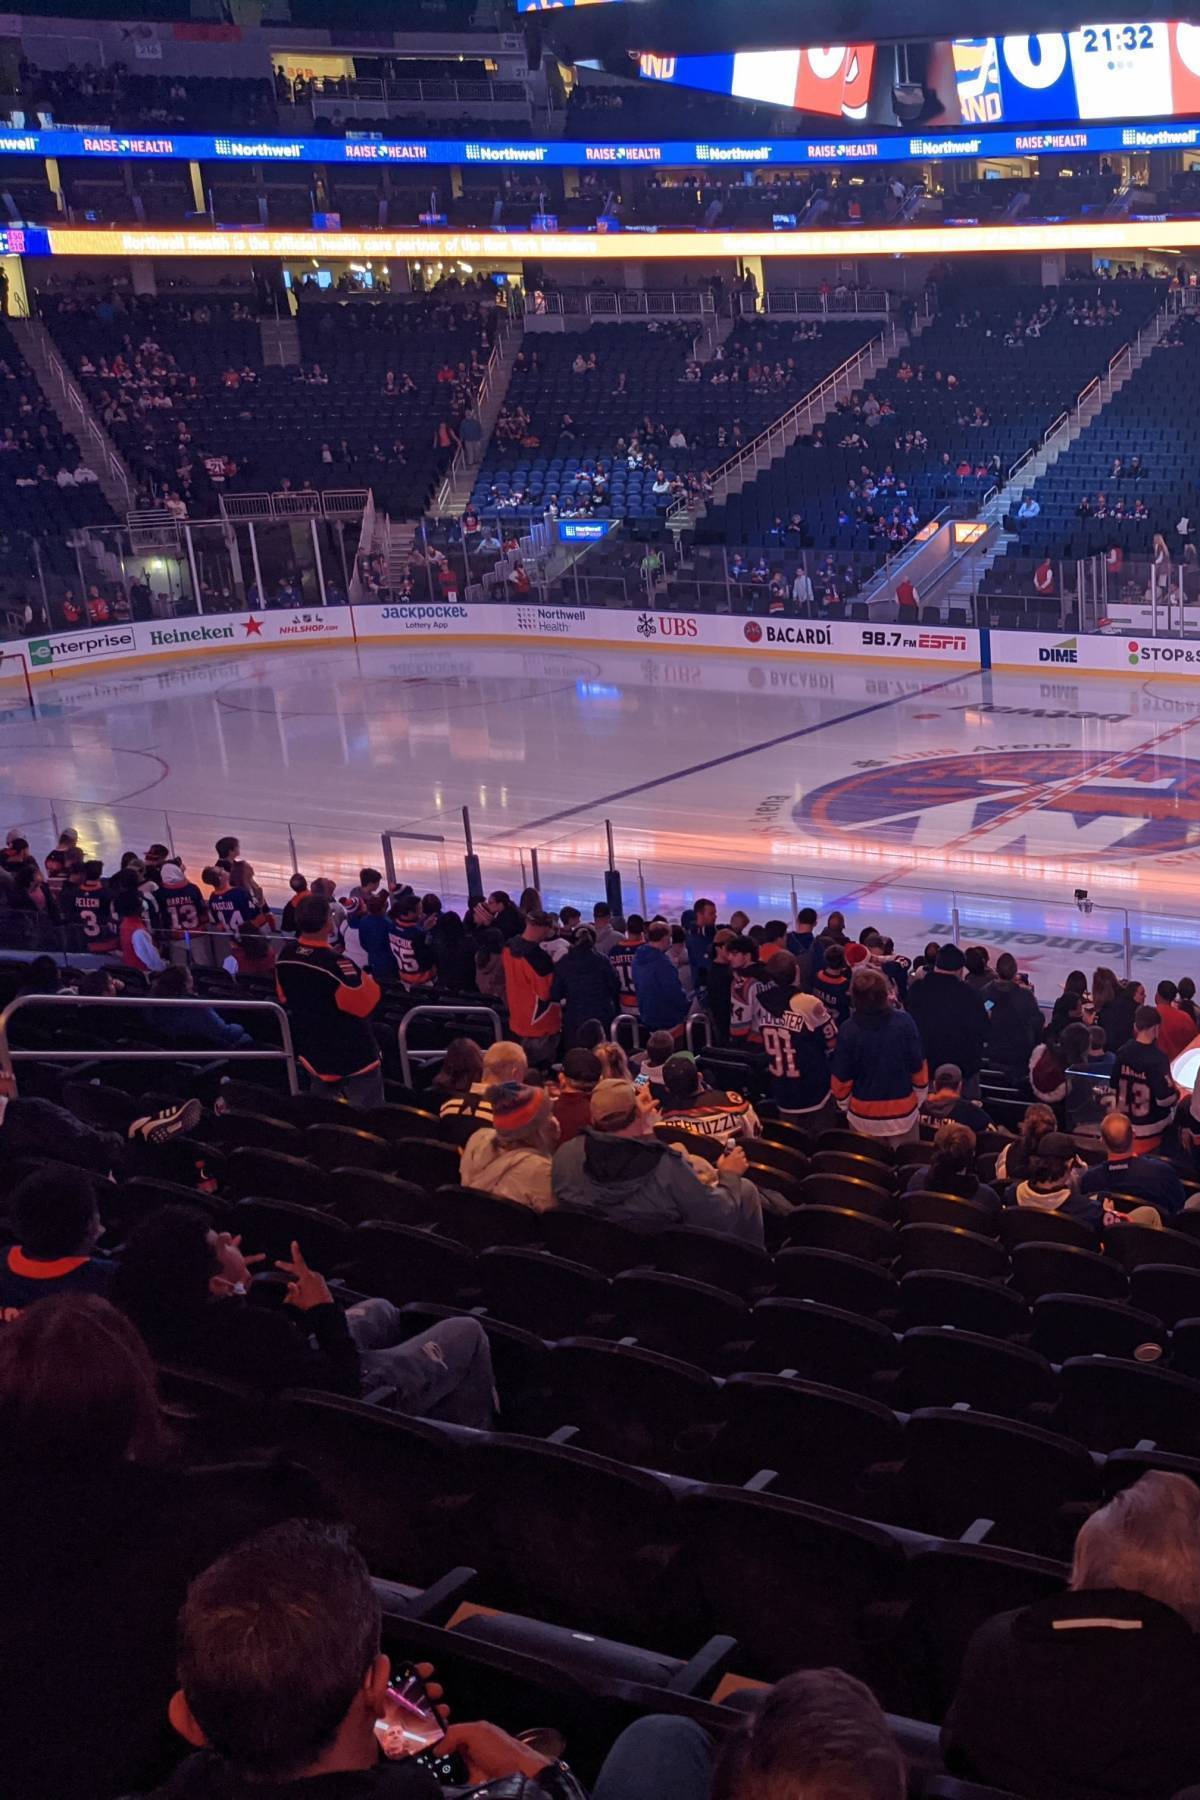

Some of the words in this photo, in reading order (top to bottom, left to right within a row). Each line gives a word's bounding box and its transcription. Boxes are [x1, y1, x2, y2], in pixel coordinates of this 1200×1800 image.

[1083, 25, 1154, 53] 21:32
[1016, 136, 1043, 149] RAISE
[1052, 134, 1087, 148] HEALTH
[1136, 130, 1197, 145] Northwell
[83, 138, 118, 152] RAISE
[131, 140, 173, 153] HEALTH
[232, 143, 301, 158] Northwell
[346, 145, 377, 158] RAISE
[389, 147, 427, 159] HEALTH
[808, 145, 837, 158] RAISE
[845, 144, 878, 157] HEALTH
[923, 140, 979, 154] Northwell
[481, 149, 544, 161] Northwell
[586, 147, 616, 160] RAISE
[626, 147, 661, 160] HEALTH
[710, 147, 769, 160] Northwell
[537, 609, 586, 621] Northwell
[405, 622, 431, 630] Lottery
[433, 622, 448, 631] App
[538, 621, 569, 632] Health
[659, 617, 698, 637] UBS
[150, 624, 234, 647] Heineken
[862, 631, 902, 646] 98.7
[903, 639, 917, 648] FM
[918, 634, 967, 651] ESPN
[36, 633, 132, 658] enterprise
[1039, 647, 1078, 664] DIME
[972, 742, 1072, 753] Arena
[80, 910, 101, 937] 3
[167, 904, 198, 930] 13
[763, 1026, 800, 1077] 91
